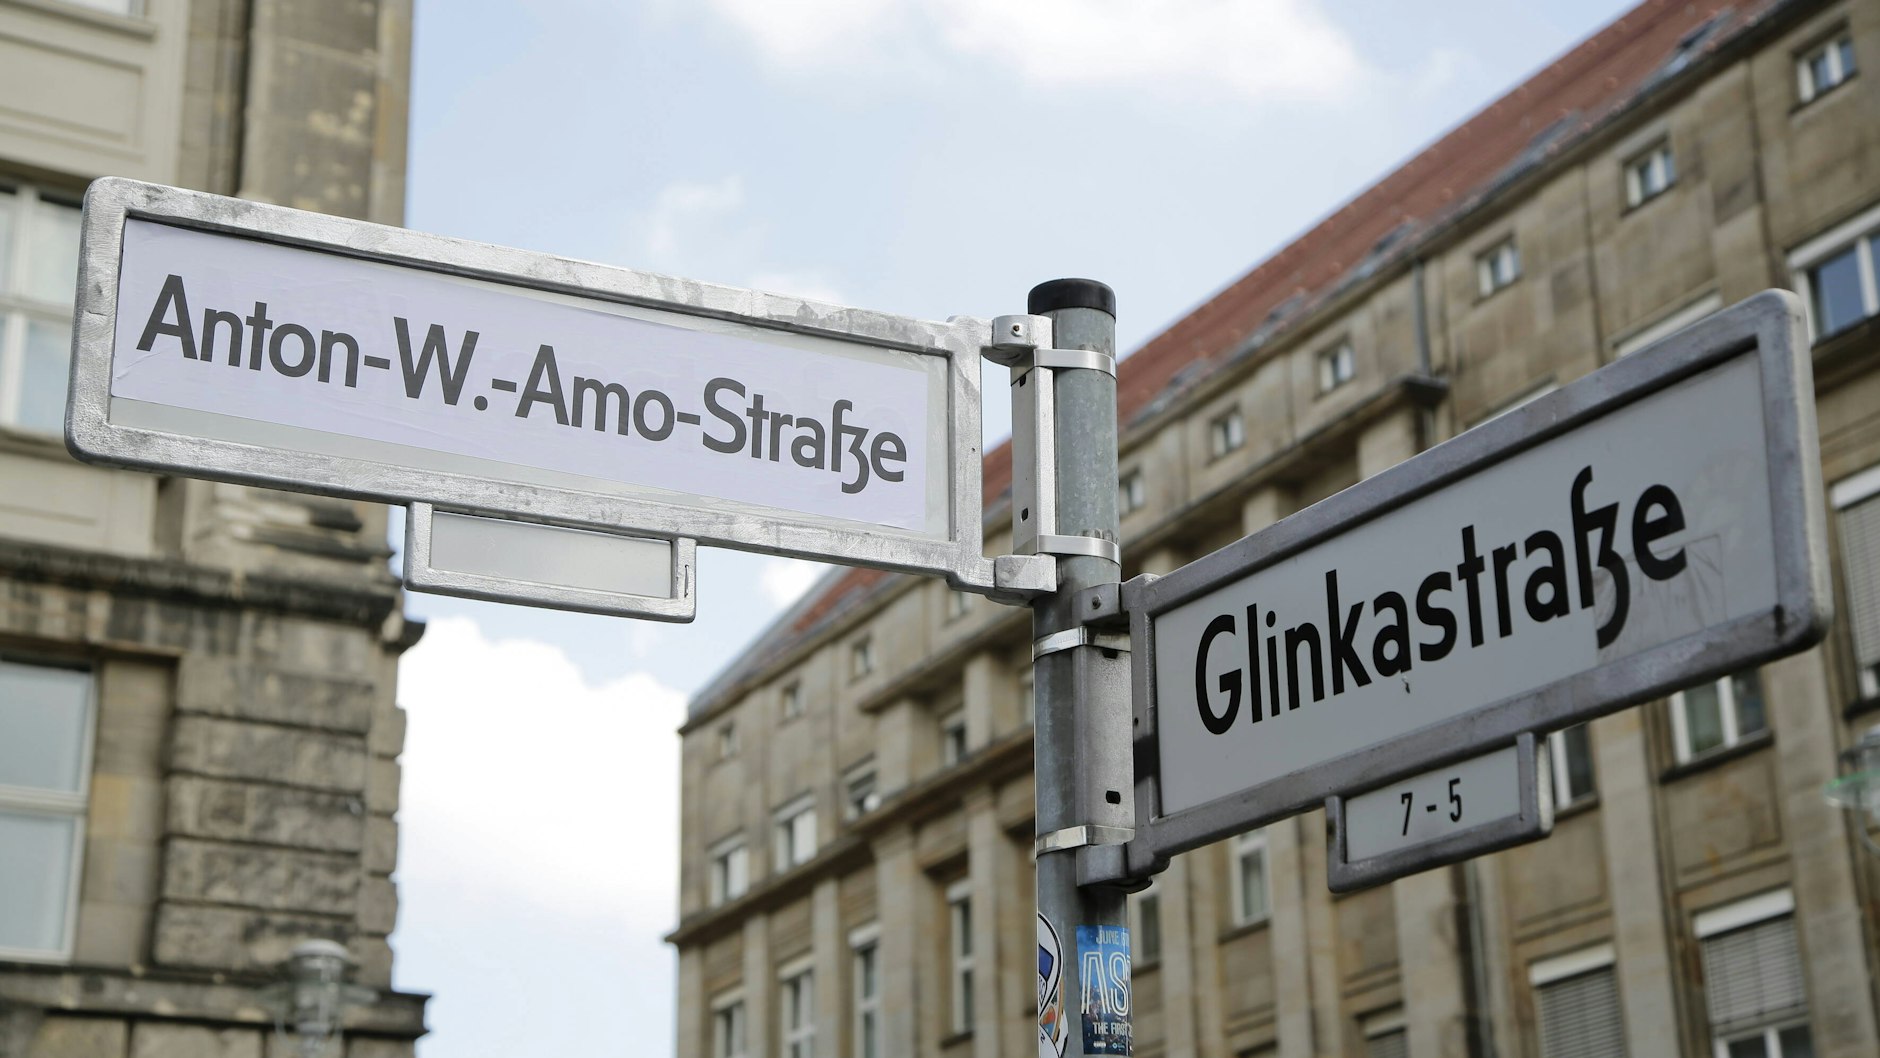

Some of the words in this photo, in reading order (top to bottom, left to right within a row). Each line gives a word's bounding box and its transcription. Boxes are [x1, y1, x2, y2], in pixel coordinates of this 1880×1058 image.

[136, 274, 907, 494] Anton-W.-Amo-Straße
[1195, 465, 1688, 736] Glinkastraße
[1400, 791, 1414, 837] 7
[1426, 804, 1438, 813] -
[1448, 777, 1463, 823] 5
[1096, 930, 1119, 946] JUNE
[1092, 1021, 1109, 1035] THE
